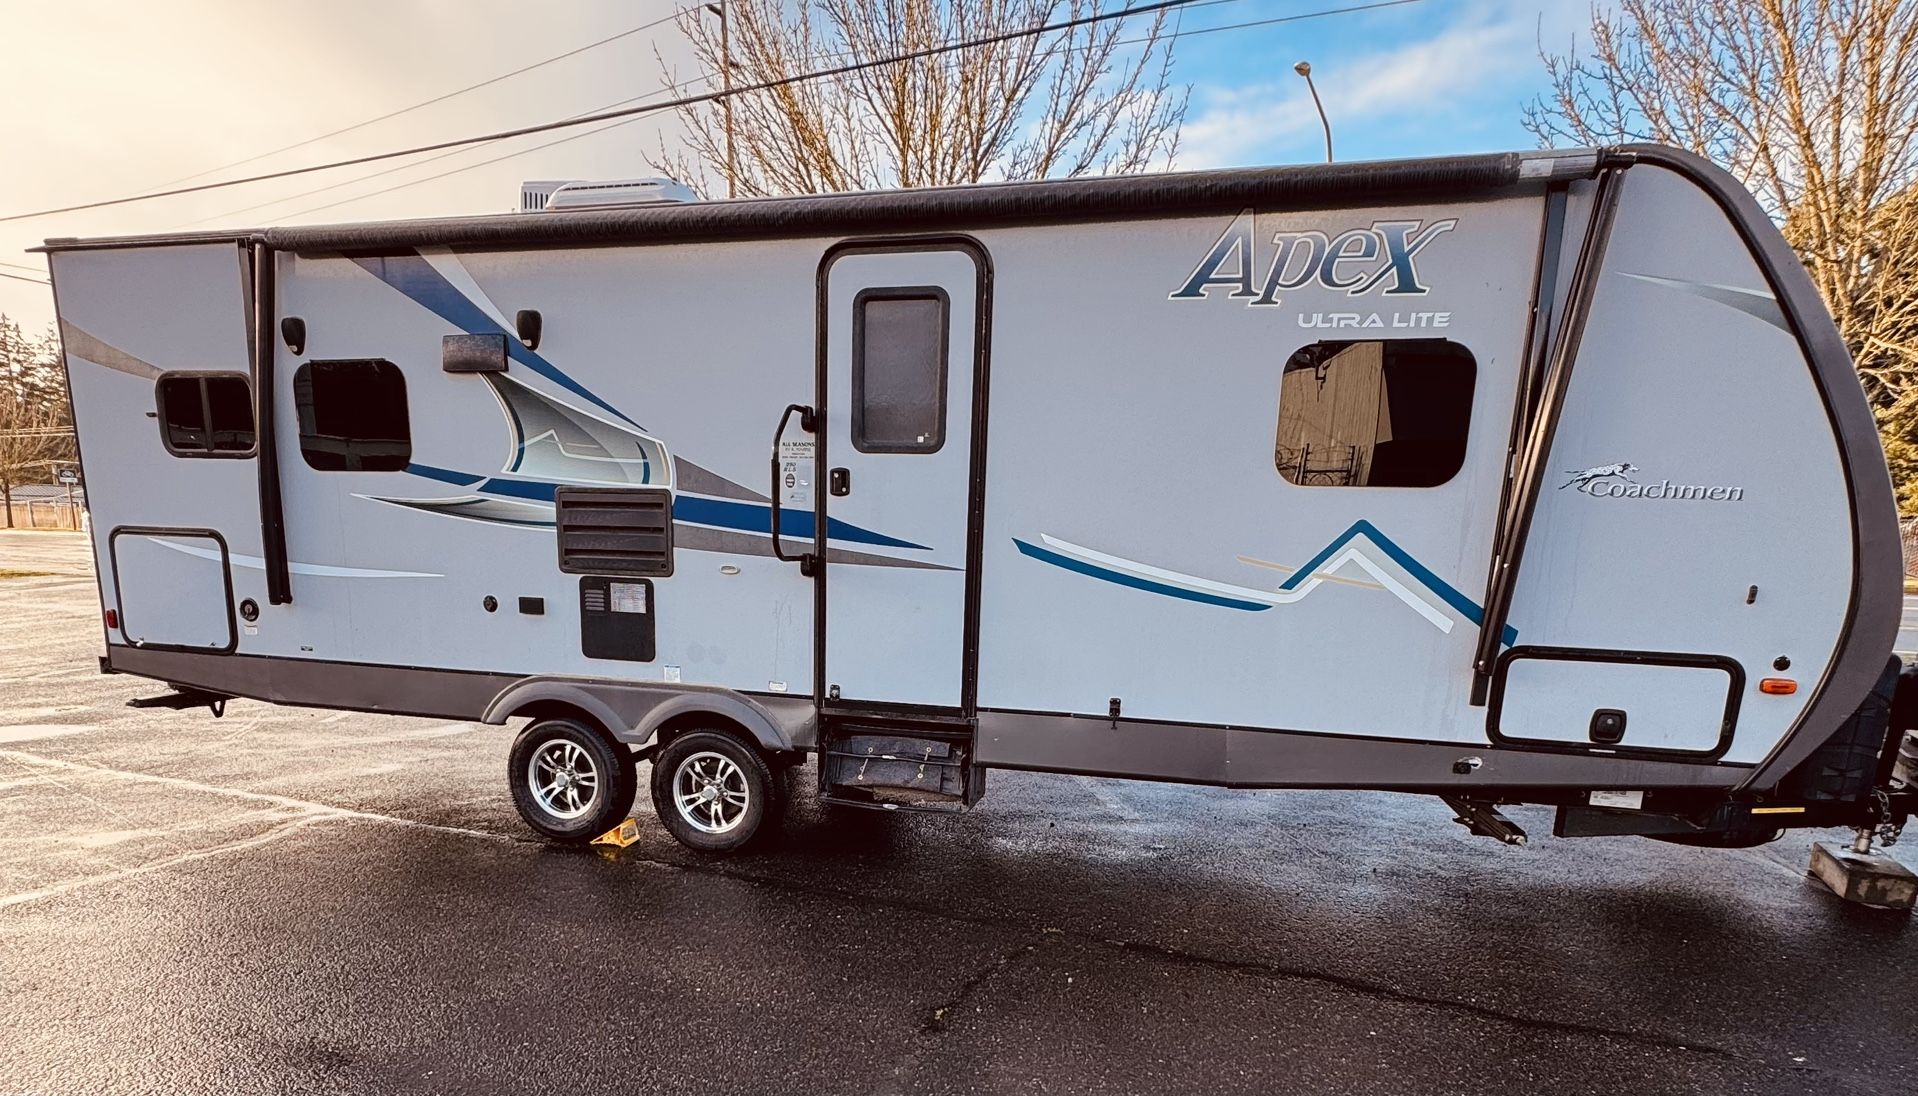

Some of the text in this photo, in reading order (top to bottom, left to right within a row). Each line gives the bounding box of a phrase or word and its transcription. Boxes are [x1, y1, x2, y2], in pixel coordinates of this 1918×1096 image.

[1168, 208, 1459, 308] Apex
[1298, 311, 1452, 328] ULTRA LITE
[1587, 480, 1744, 501] Coachmen
